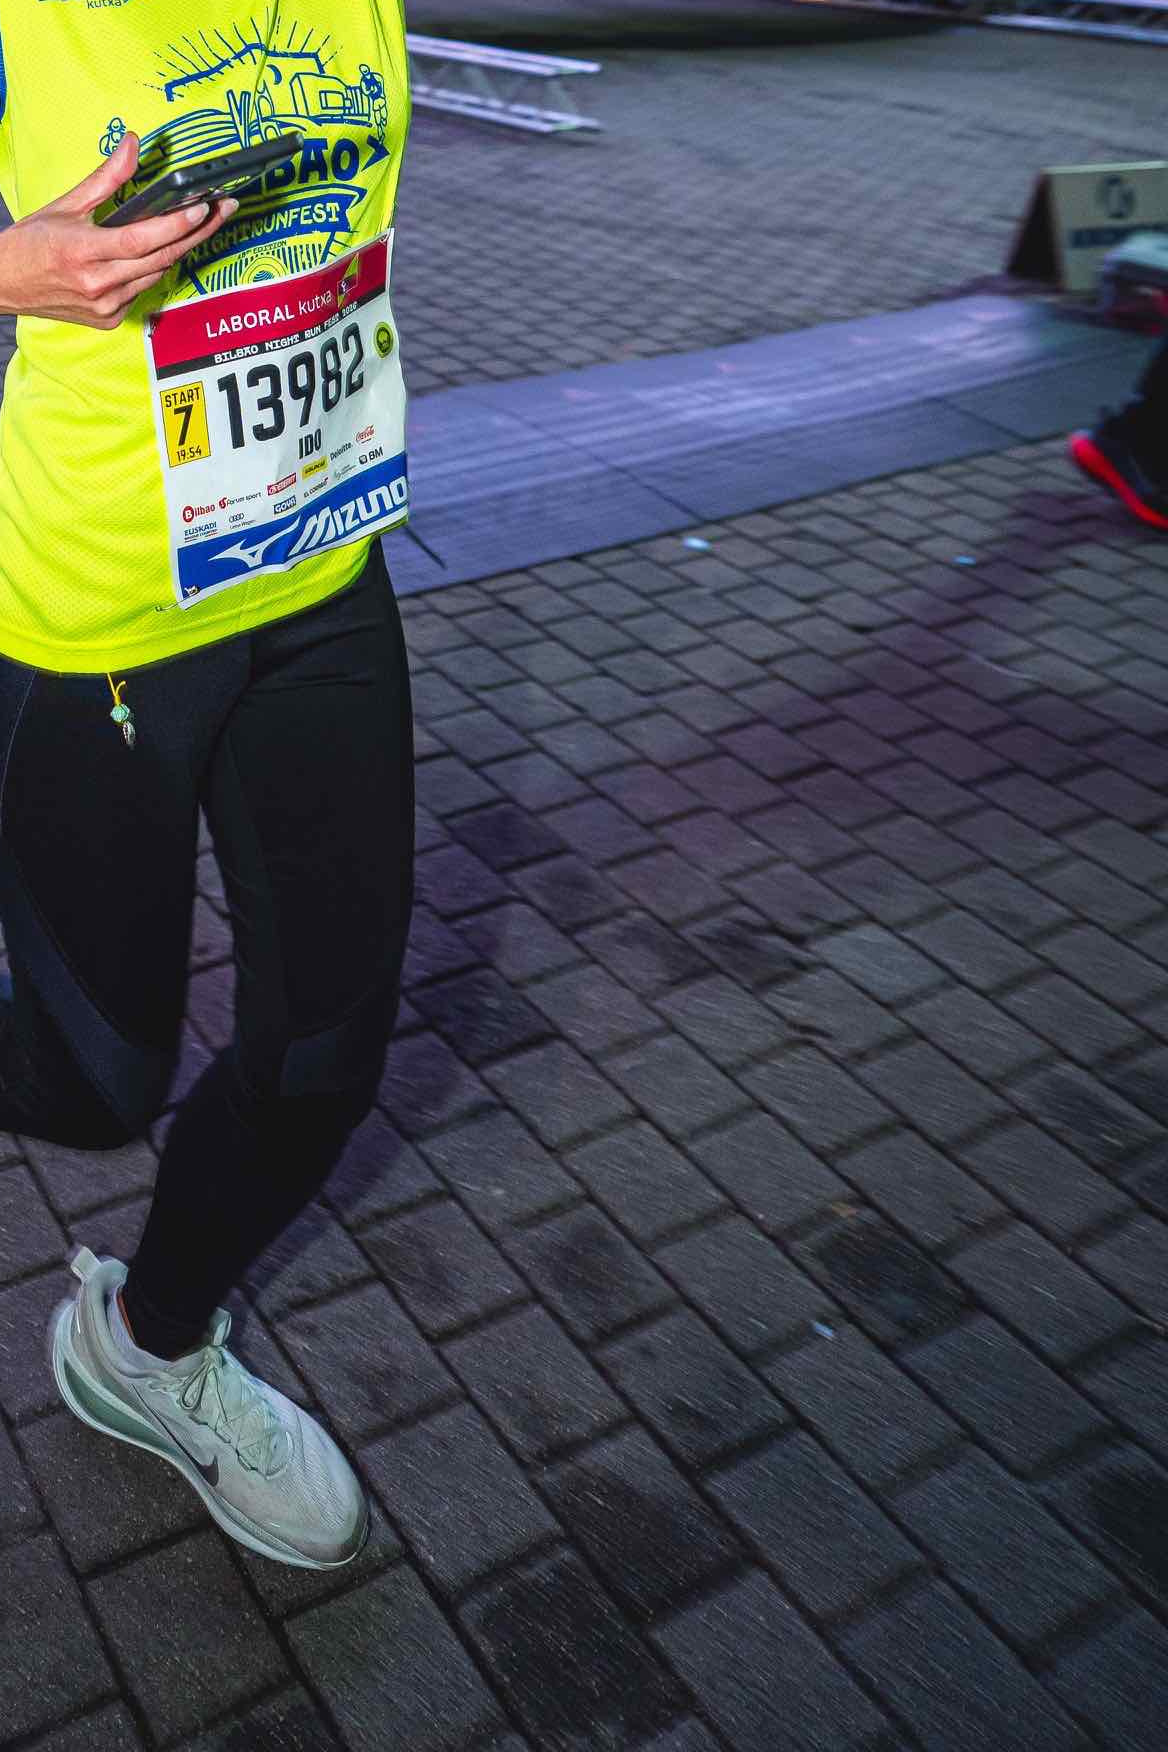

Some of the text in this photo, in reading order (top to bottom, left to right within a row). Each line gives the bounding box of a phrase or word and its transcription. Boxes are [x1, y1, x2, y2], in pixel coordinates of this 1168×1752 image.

[205, 288, 333, 338] LABORAL kutxa
[214, 346, 259, 364] BILBAO
[265, 335, 300, 351] NIGHT
[304, 326, 321, 340] RUN
[164, 386, 201, 408] START
[217, 322, 364, 449] 13982
[173, 404, 193, 446] 7
[298, 429, 322, 460] IDO
[368, 447, 384, 461] BM
[184, 521, 217, 536] EUSKADI
